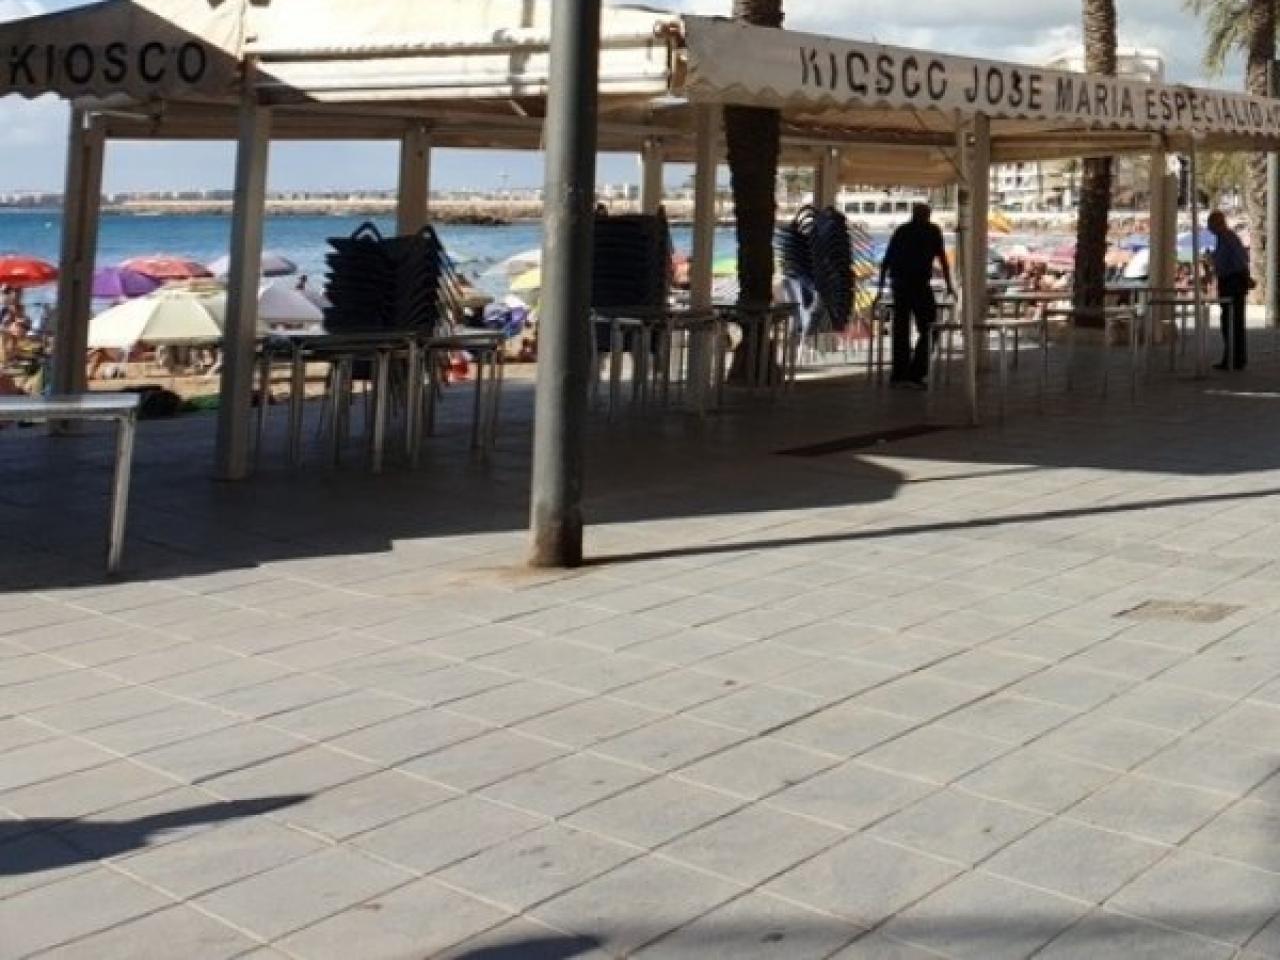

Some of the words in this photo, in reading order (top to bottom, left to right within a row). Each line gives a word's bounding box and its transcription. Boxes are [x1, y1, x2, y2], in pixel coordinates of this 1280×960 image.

[8, 42, 206, 86] KIOSCO
[799, 46, 947, 101] KIOSCO
[964, 63, 1043, 111] JOSE
[1055, 76, 1134, 118] MARIA
